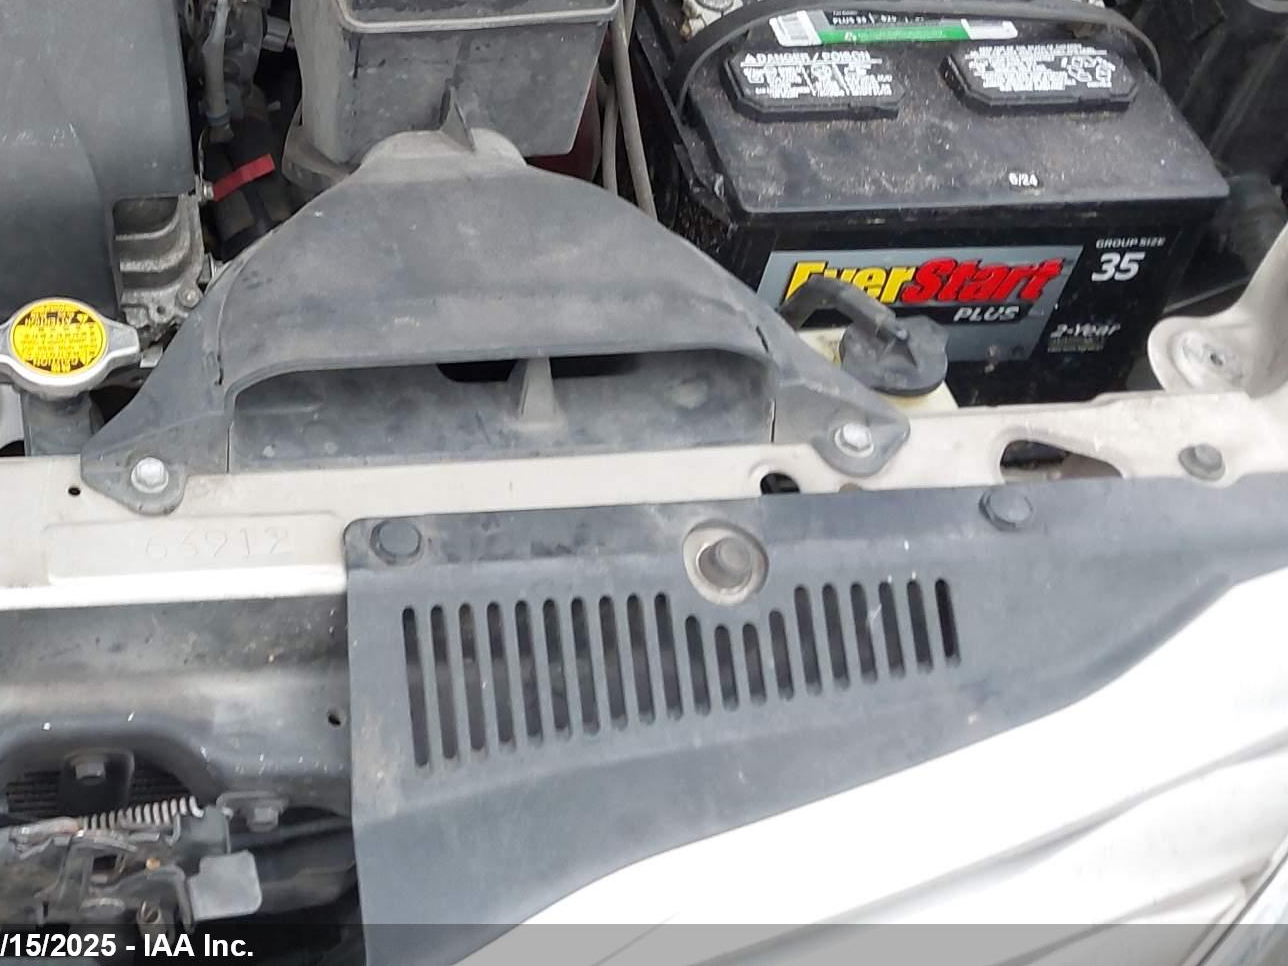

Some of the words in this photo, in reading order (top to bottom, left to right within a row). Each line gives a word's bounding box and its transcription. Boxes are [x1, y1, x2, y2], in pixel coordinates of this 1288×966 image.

[1095, 238, 1138, 249] GROUP
[1139, 236, 1166, 247] SIZE
[1091, 251, 1146, 282] 35
[953, 305, 1019, 322] PLUS
